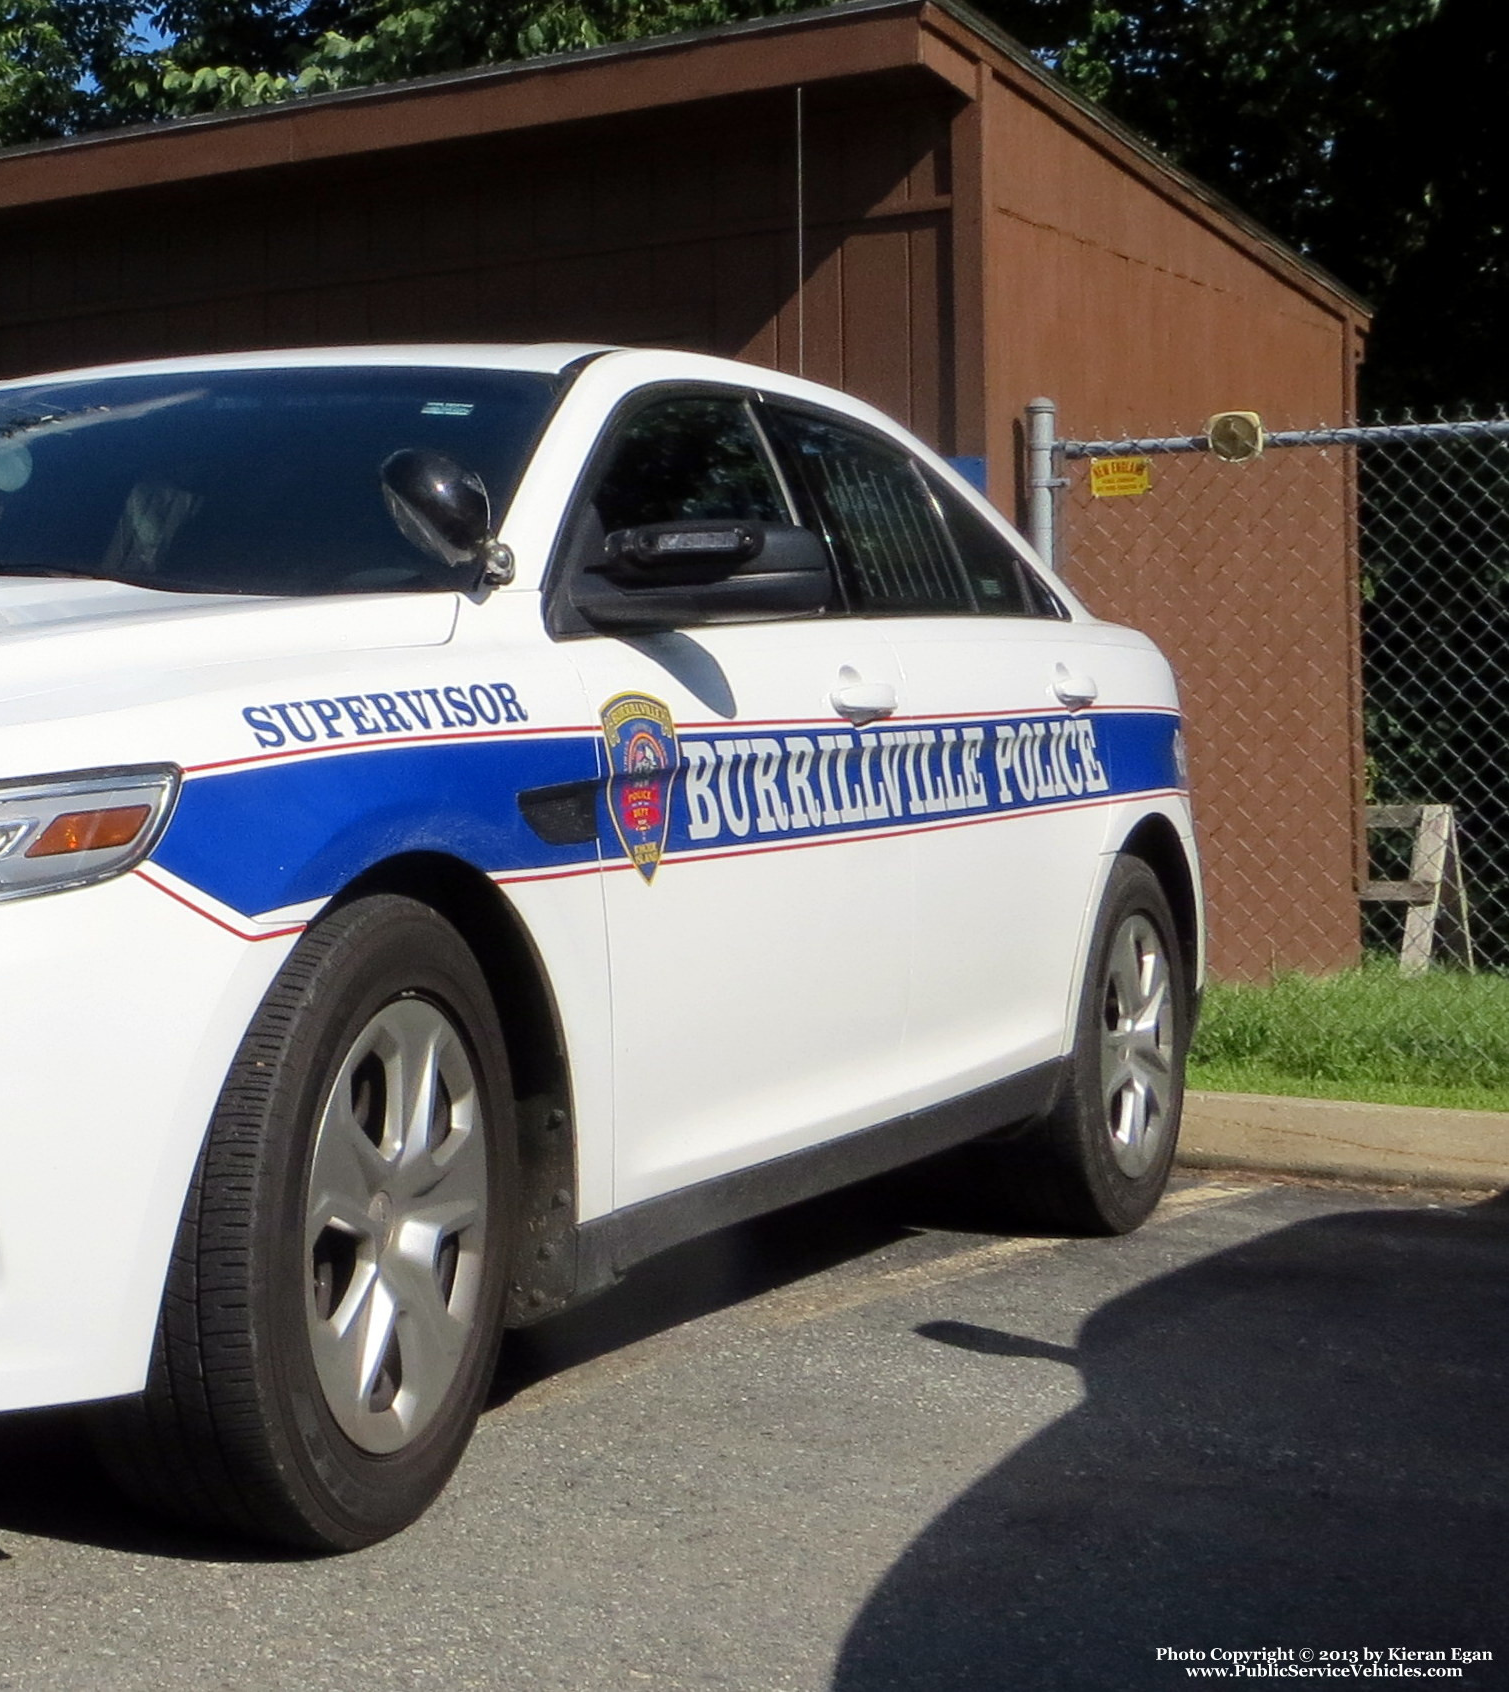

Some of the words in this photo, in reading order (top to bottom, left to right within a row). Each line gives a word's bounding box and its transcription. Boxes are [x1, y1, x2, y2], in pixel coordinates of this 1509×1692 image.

[241, 682, 528, 748] SUPERVISOR
[683, 727, 987, 840] BURRILLVILLE
[994, 718, 1111, 804] POLICE
